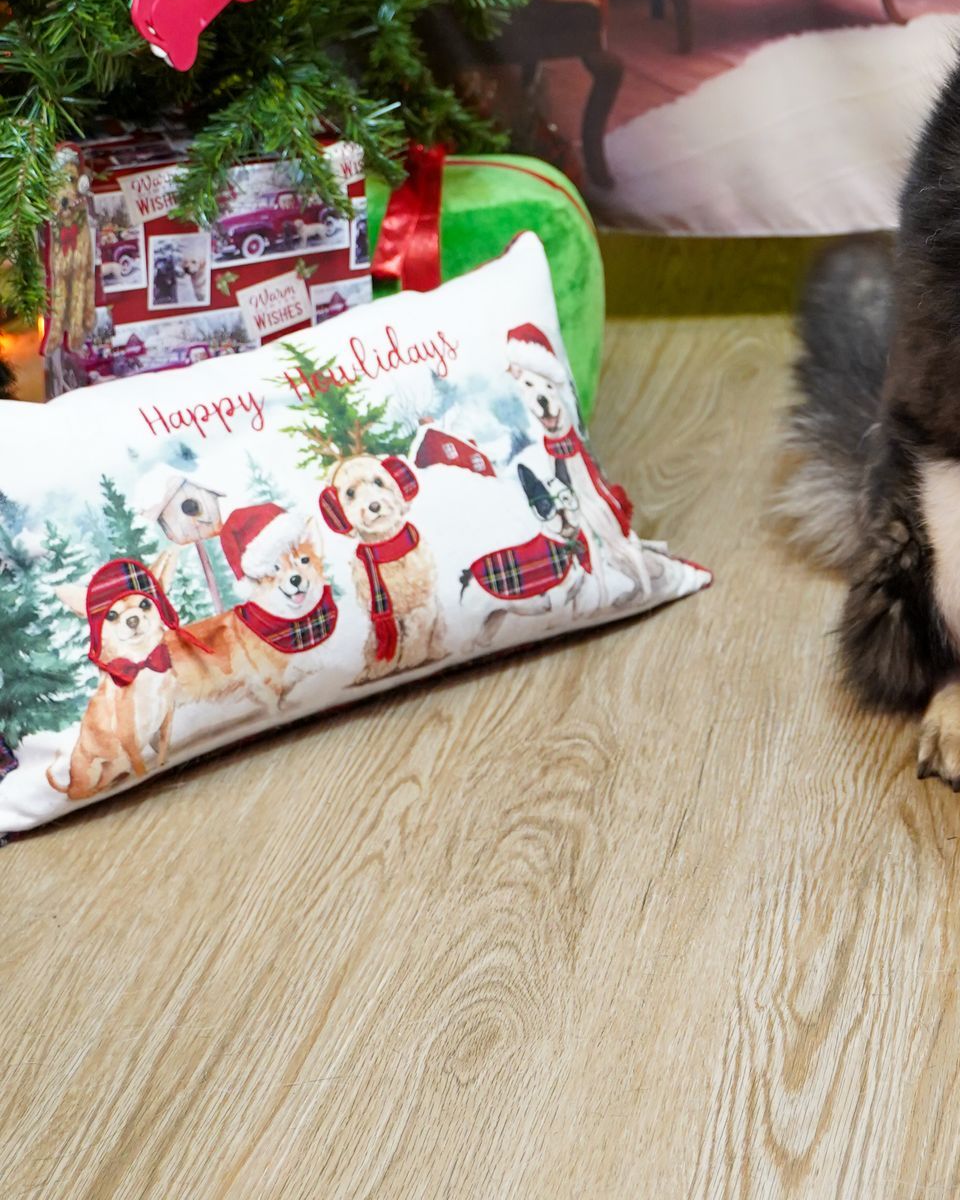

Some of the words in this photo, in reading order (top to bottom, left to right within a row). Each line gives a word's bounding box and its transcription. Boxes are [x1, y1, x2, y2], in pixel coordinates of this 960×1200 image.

[340, 159, 365, 179] WIS
[136, 192, 178, 216] WISH
[249, 286, 295, 308] Warm
[254, 302, 304, 330] WISHES
[138, 391, 265, 438] Happy
[283, 325, 460, 402] Howlidays
